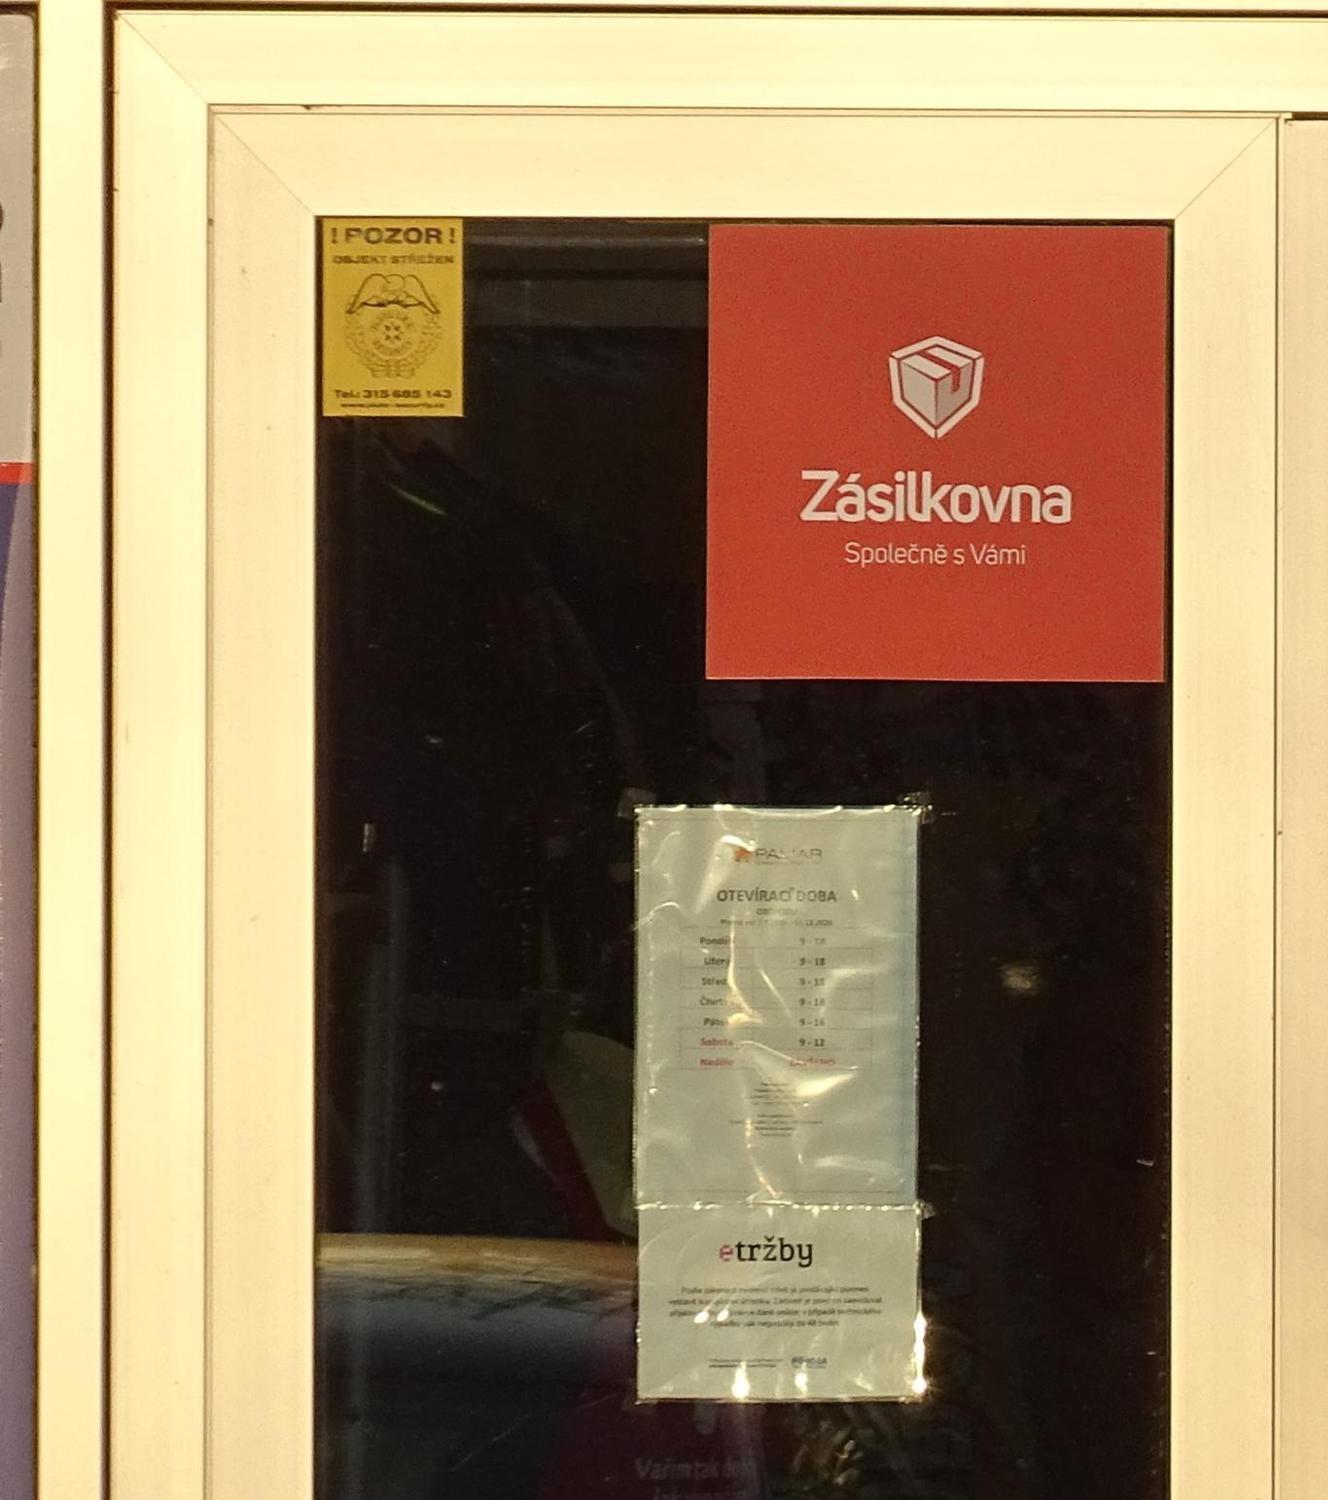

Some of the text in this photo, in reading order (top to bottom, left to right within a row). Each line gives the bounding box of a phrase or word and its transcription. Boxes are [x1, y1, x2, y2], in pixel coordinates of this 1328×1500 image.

[800, 470, 1073, 523] Zásilkovna
[844, 541, 1027, 568] Společně s Vámi
[719, 1236, 814, 1268] etržby
